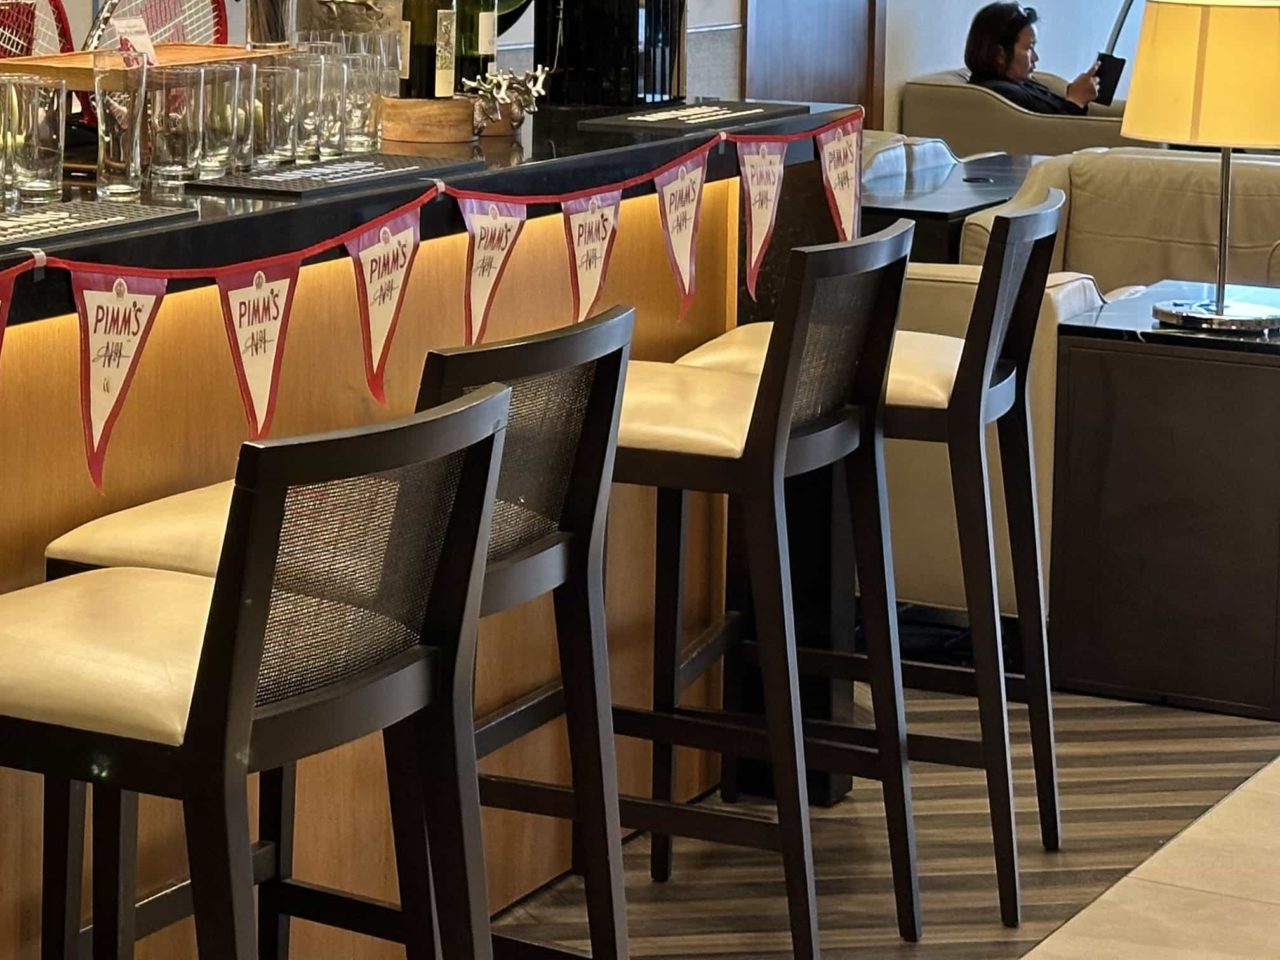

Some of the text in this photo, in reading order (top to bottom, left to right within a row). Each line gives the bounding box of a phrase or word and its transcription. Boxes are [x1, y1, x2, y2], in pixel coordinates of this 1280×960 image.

[750, 160, 776, 186] PIMM'S
[669, 178, 696, 215] PIMM'S
[477, 222, 511, 251] PIMM'S
[577, 213, 608, 247] PIMM'S
[369, 239, 407, 284] PIMM'S
[93, 300, 142, 337] PIMM'S
[239, 288, 280, 329] PIMM'S
